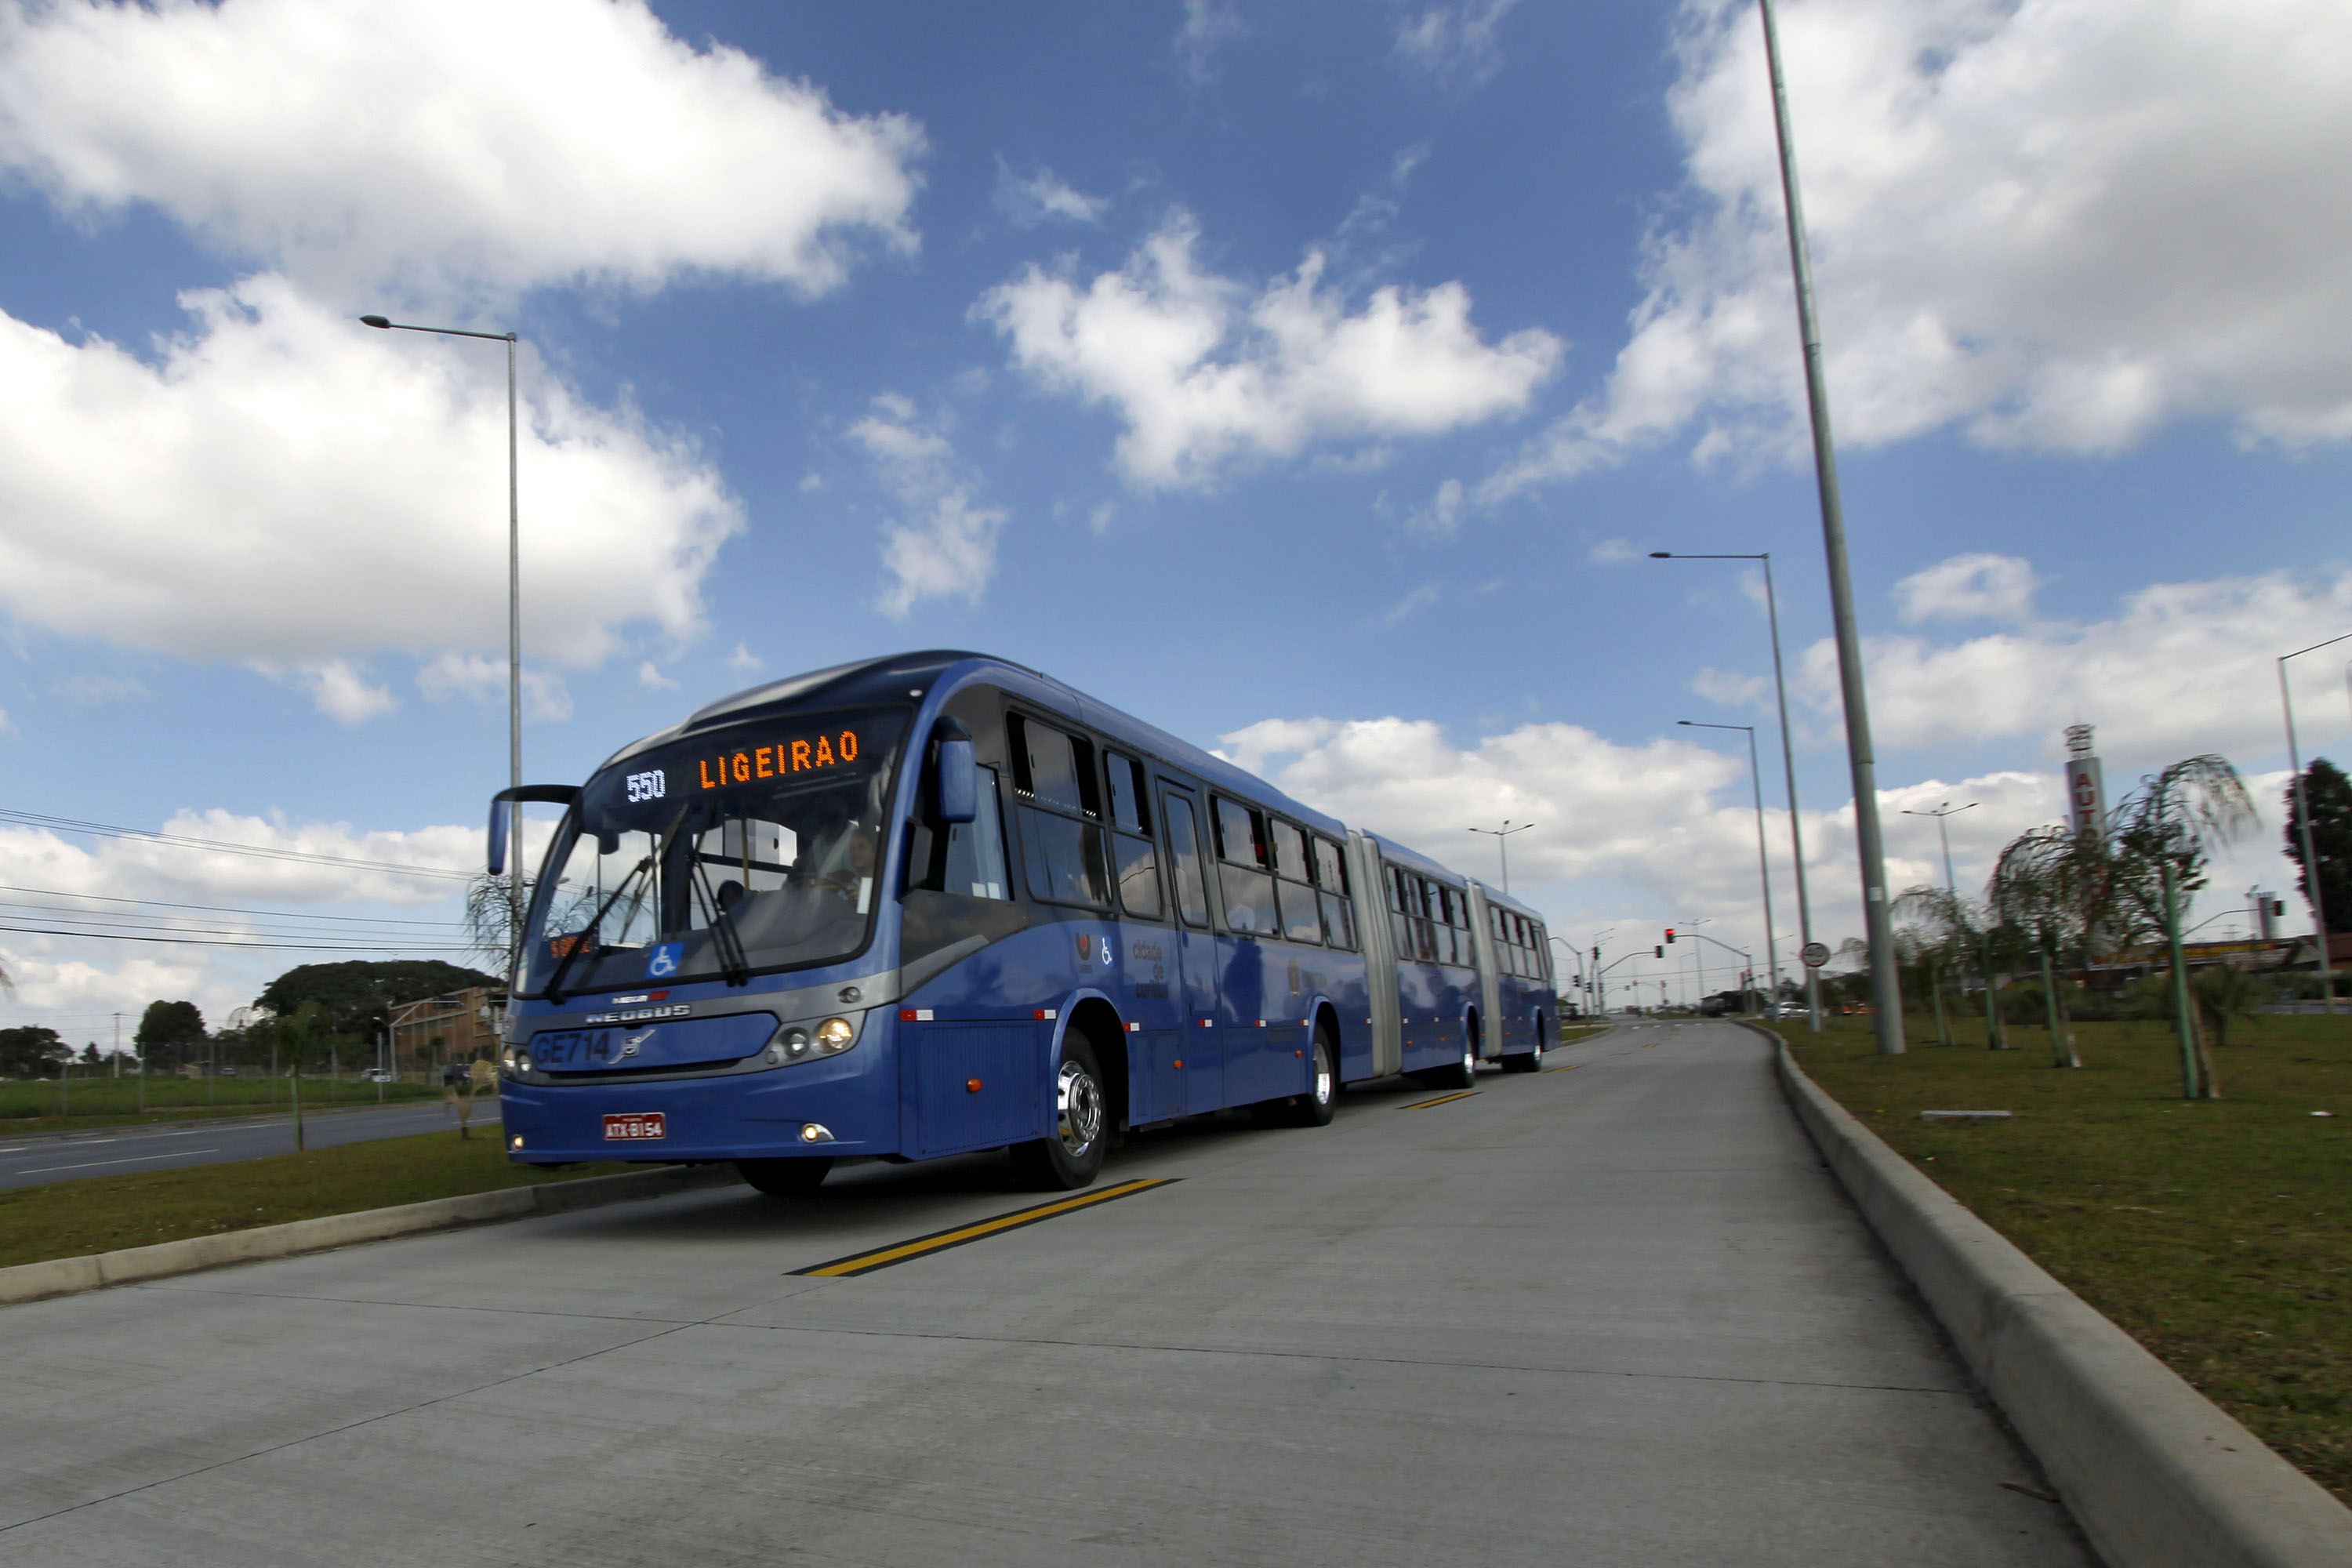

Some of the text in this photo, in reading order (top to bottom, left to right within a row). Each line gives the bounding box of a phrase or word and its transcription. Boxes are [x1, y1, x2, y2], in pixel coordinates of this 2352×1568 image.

[699, 730, 858, 789] LIGEIRAO
[626, 769, 666, 803] 550
[586, 1004, 691, 1023] NEOBUS
[535, 1031, 609, 1065] GE714
